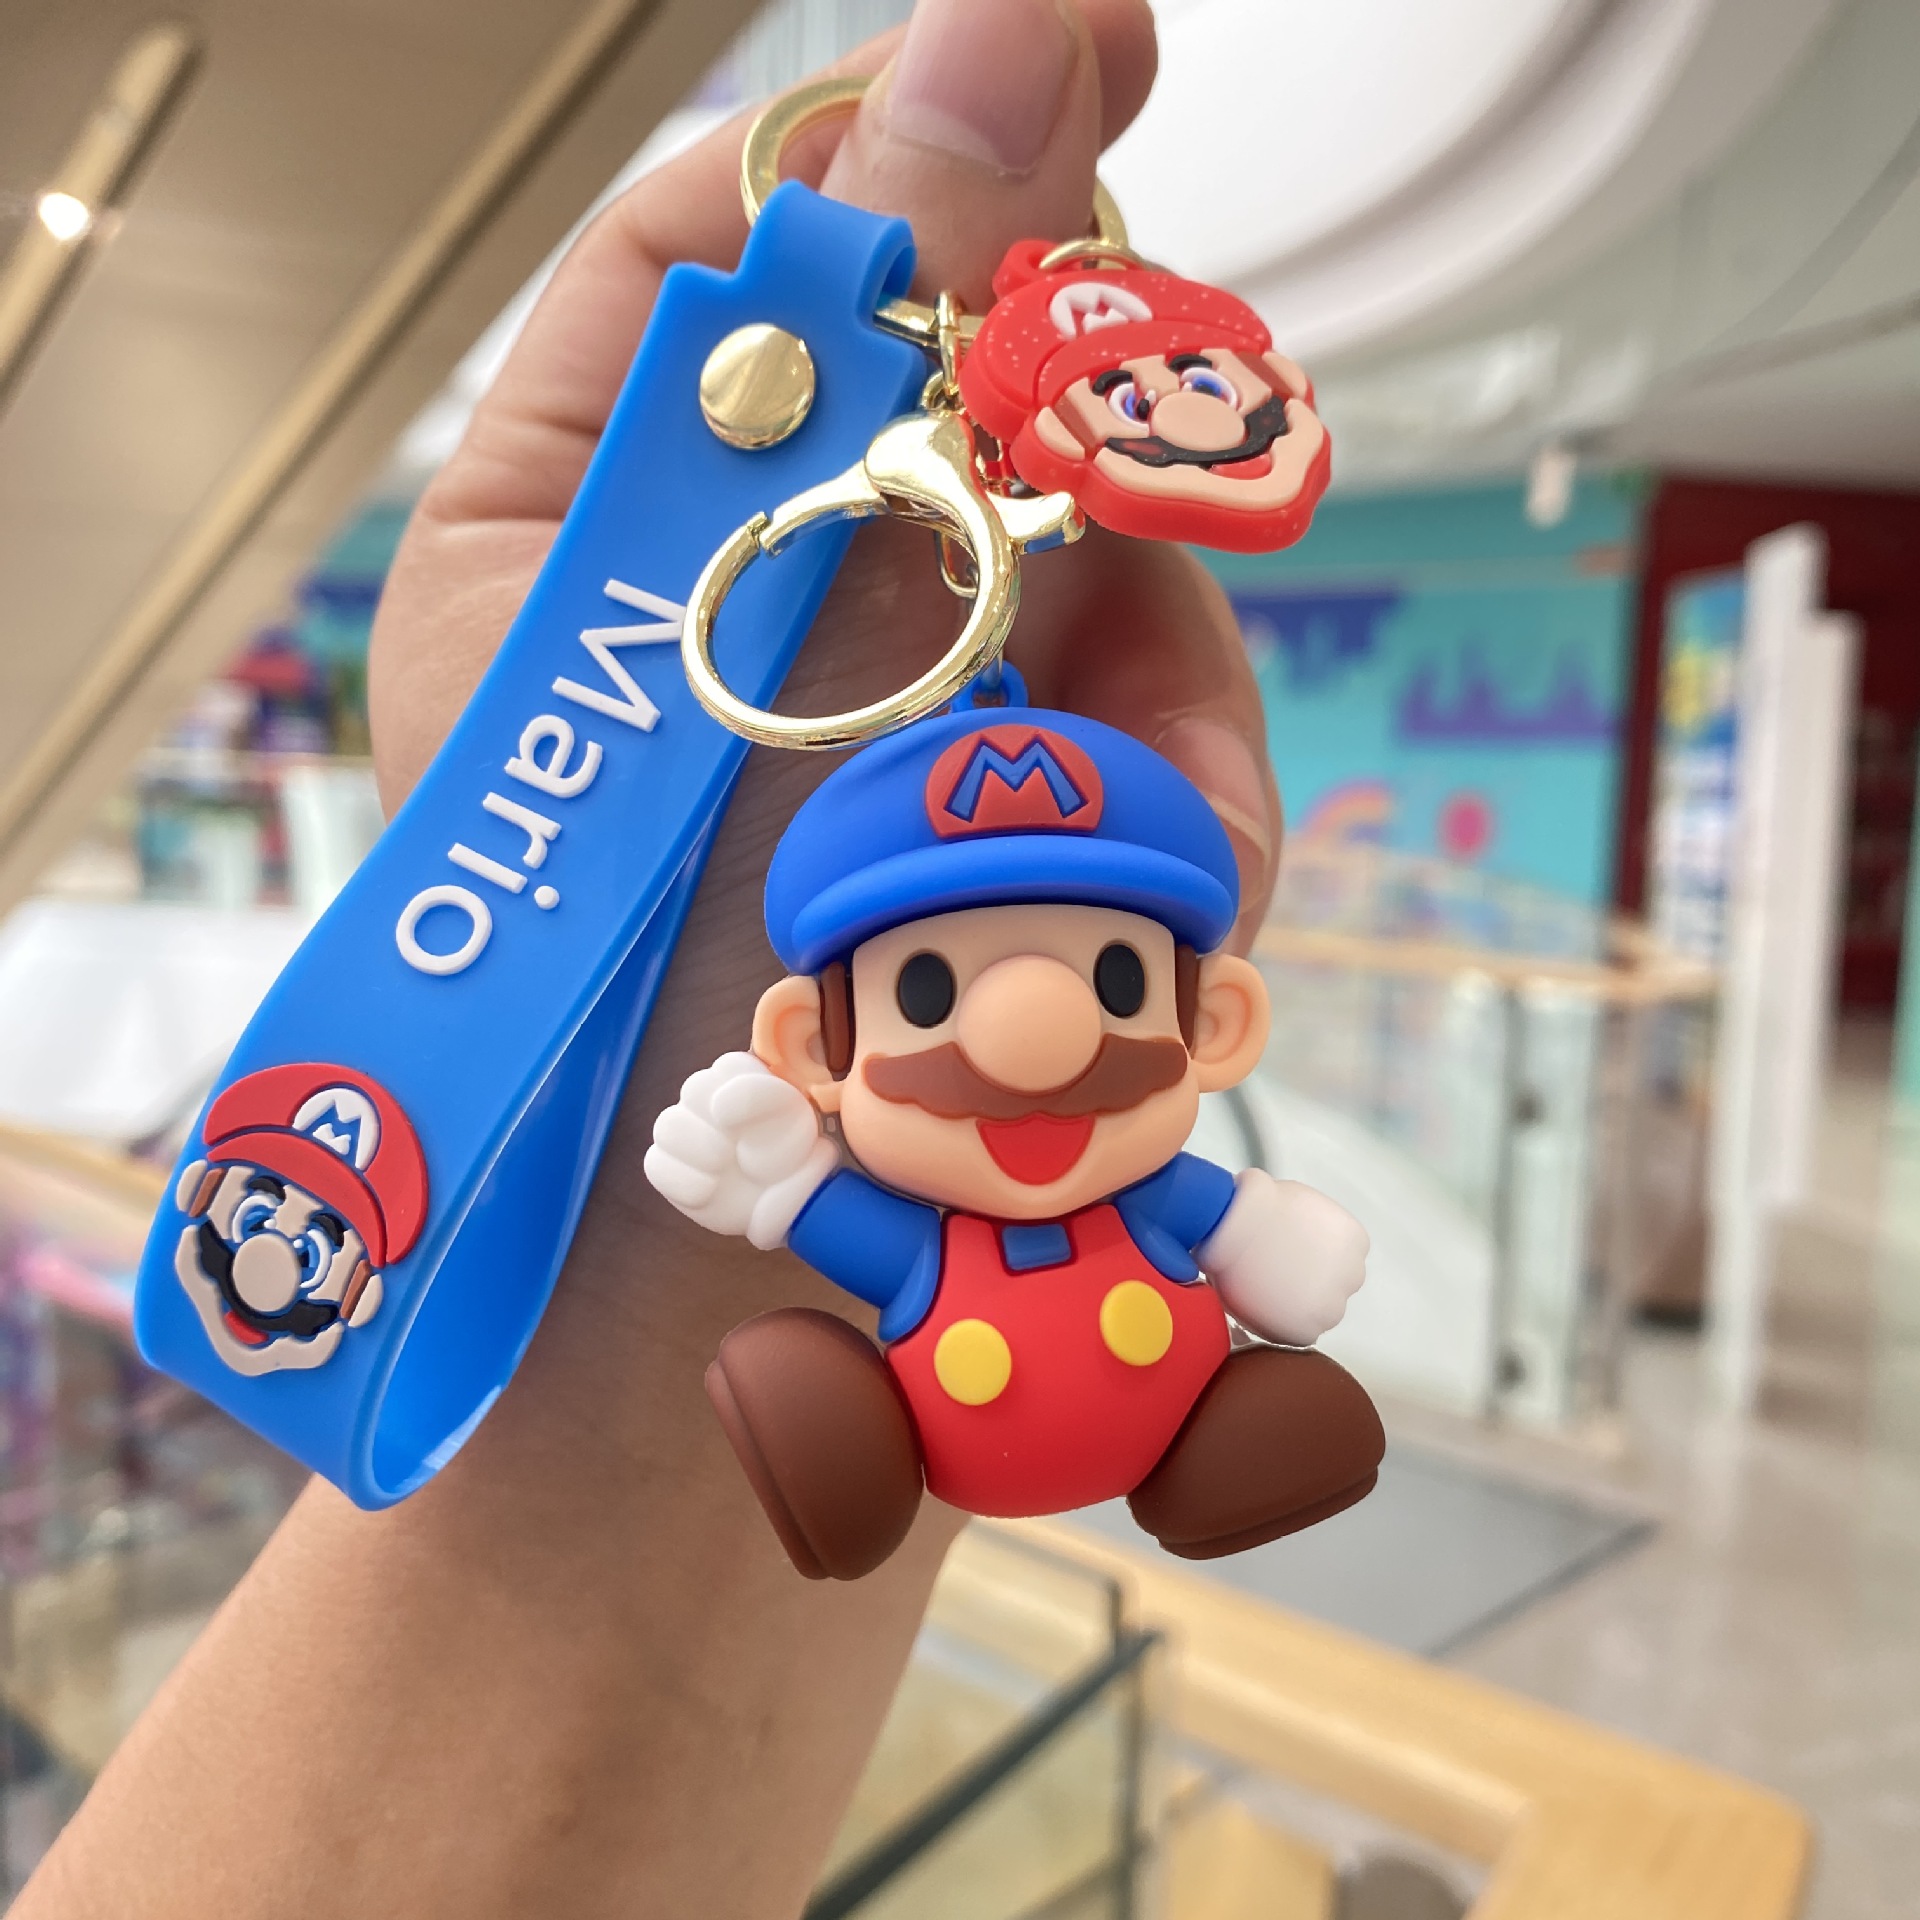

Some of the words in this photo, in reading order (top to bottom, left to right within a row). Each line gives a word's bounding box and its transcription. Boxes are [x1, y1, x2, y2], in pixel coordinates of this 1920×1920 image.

[1066, 294, 1136, 339] M
[395, 577, 688, 976] Mario
[943, 736, 1089, 824] M
[301, 1097, 364, 1171] M
